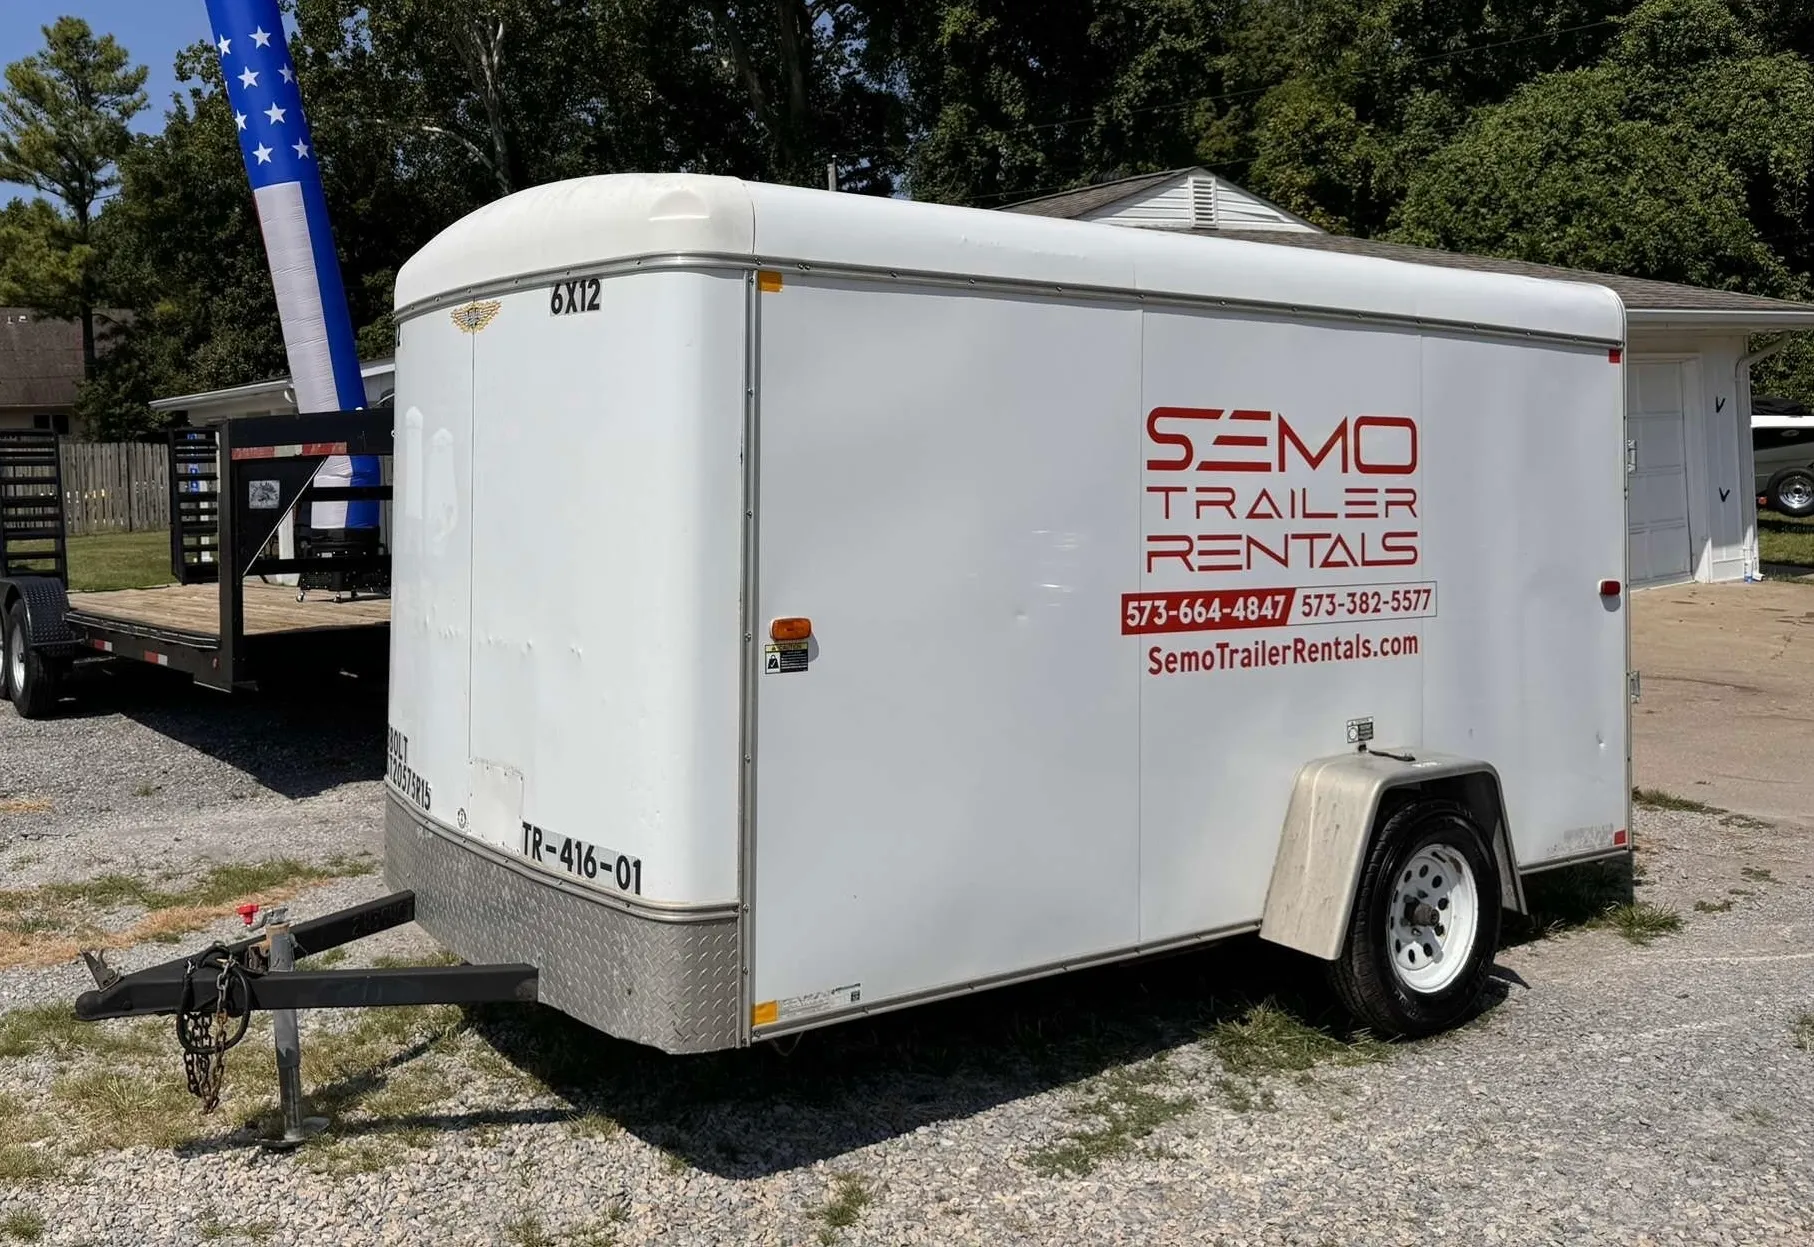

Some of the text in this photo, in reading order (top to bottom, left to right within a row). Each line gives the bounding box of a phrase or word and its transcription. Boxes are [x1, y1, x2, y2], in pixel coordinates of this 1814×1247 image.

[551, 278, 601, 315] 6X12
[1146, 406, 1418, 475] SEMO
[1146, 486, 1418, 520] TRAILER
[1146, 531, 1418, 573] RENTALS
[1126, 588, 1432, 627] 573-664-4847 573-382-5577
[1147, 634, 1419, 675] SemoTrailerRentals.com
[522, 821, 641, 896] TR-416-01
